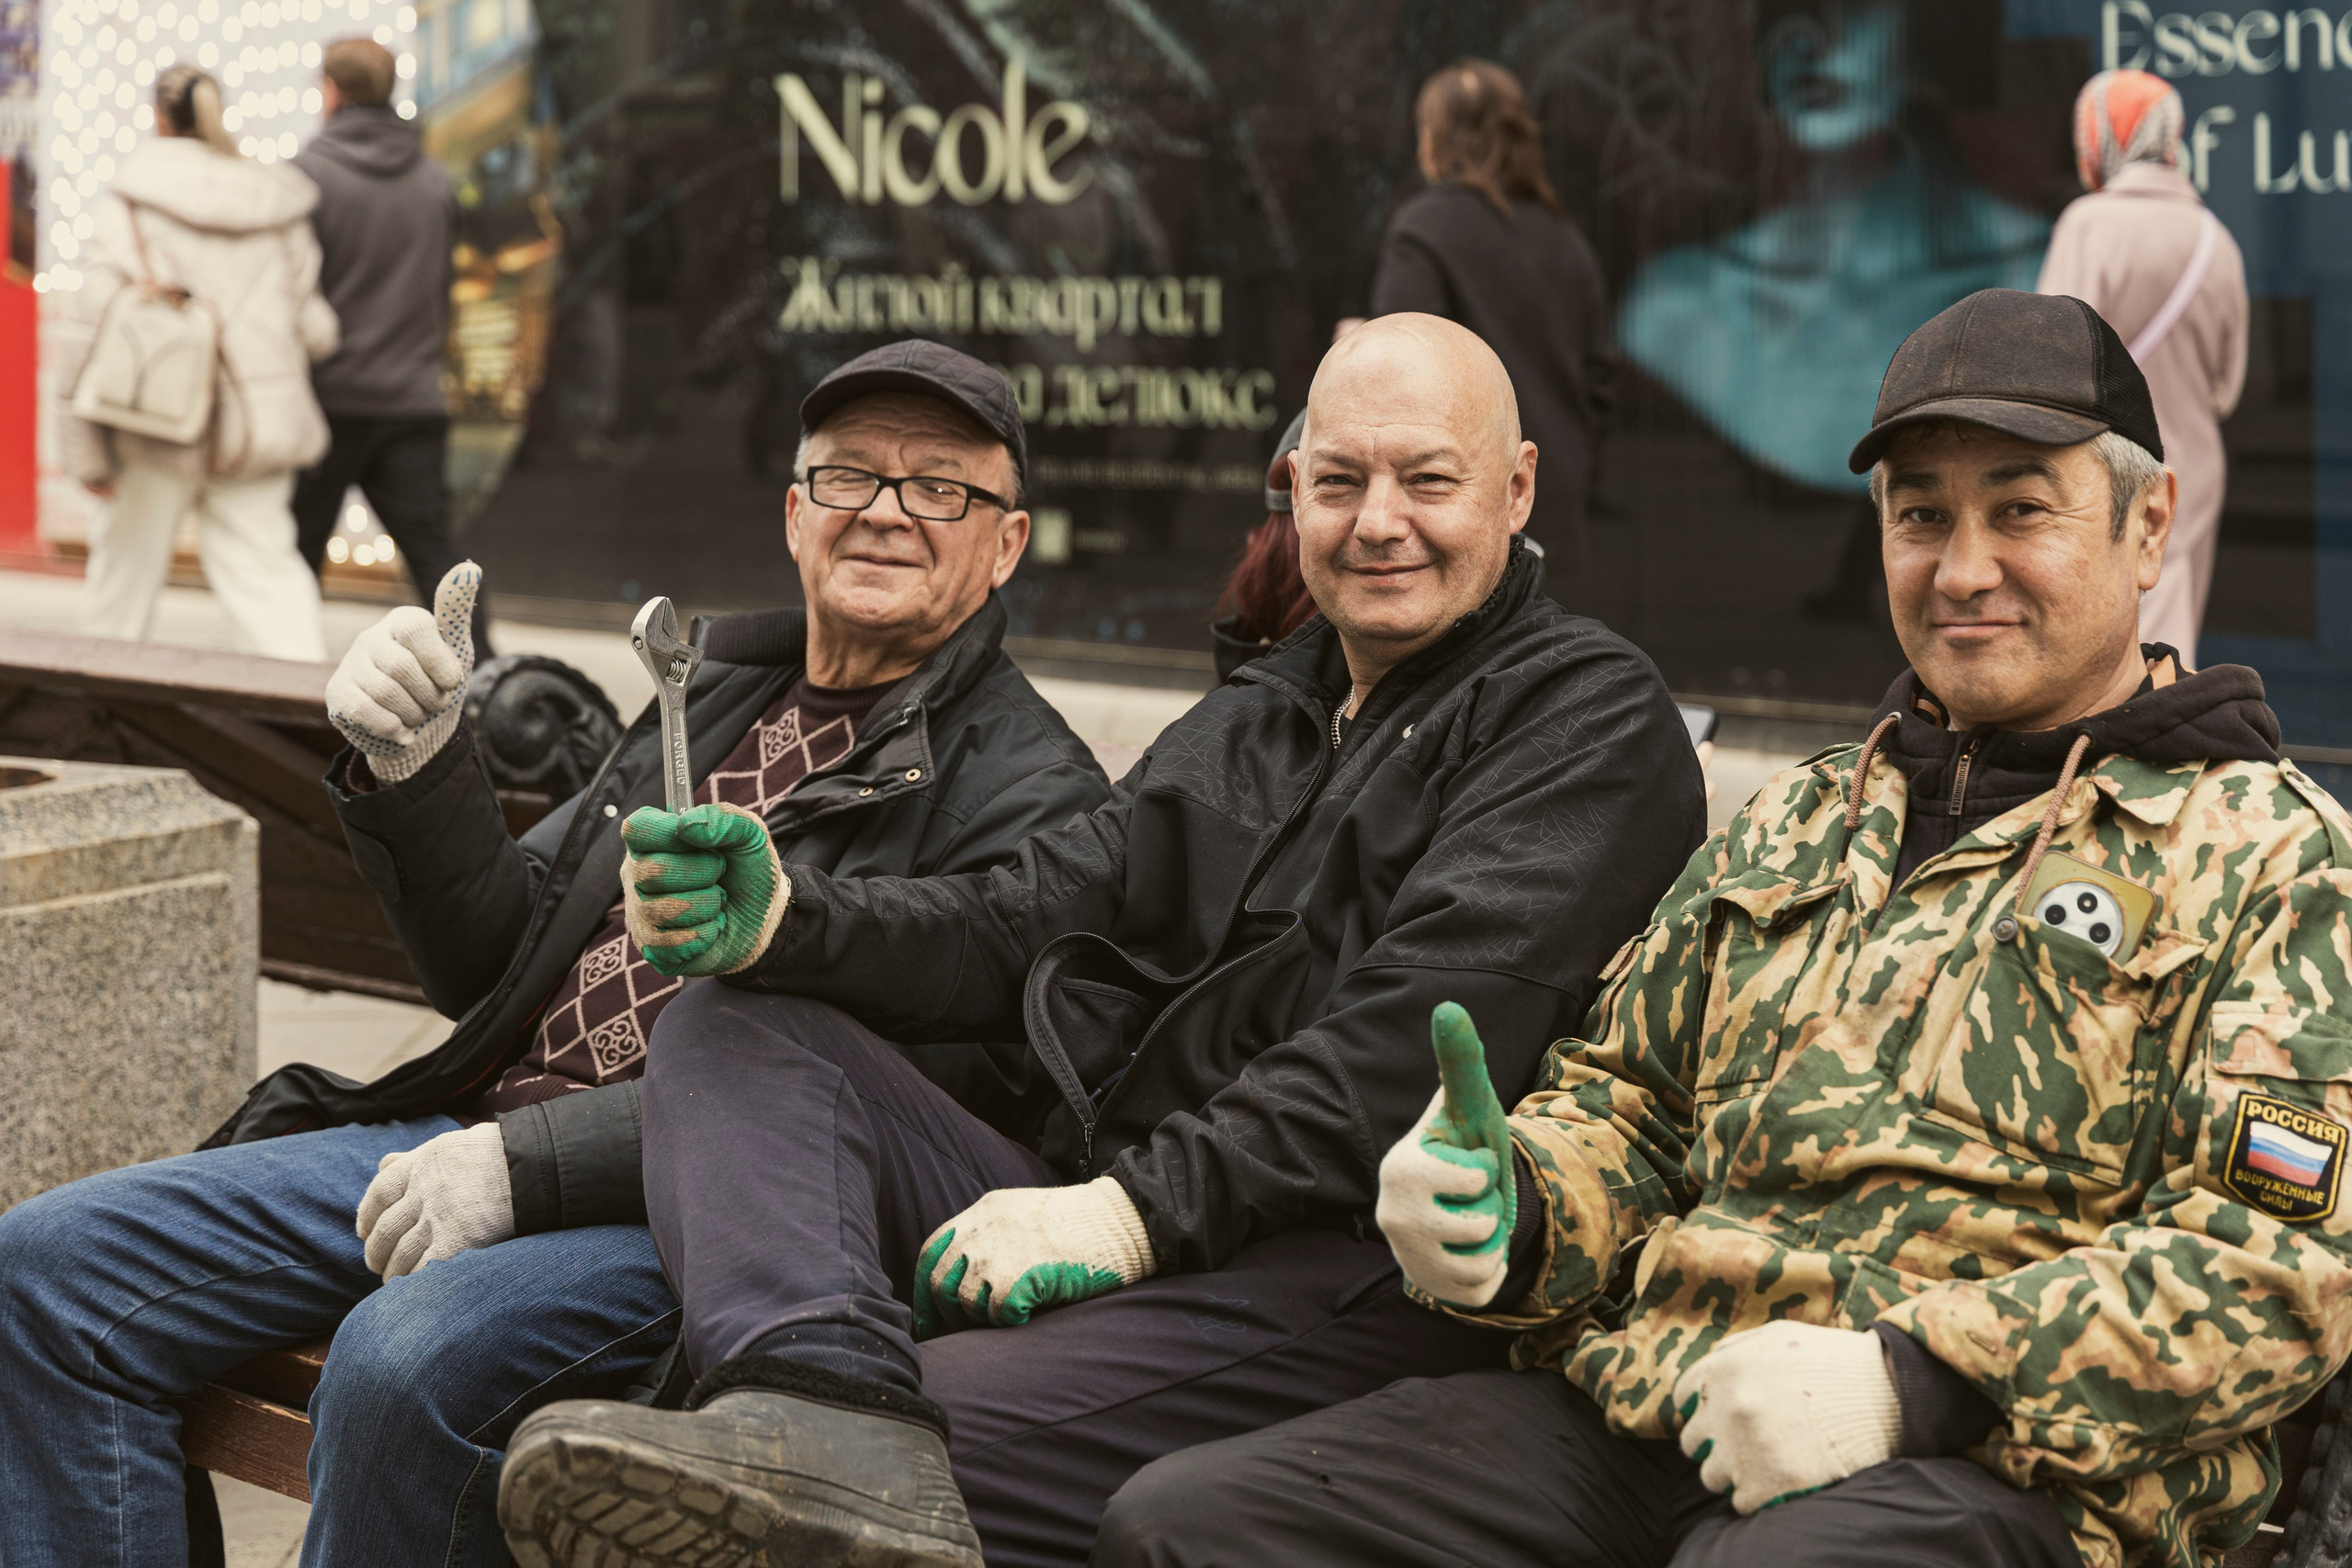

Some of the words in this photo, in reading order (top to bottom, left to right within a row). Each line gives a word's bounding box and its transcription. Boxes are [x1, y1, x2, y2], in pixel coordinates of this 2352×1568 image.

[775, 57, 1097, 206] Nicole
[2177, 105, 2236, 195] f
[979, 276, 1225, 354] квартал
[673, 732, 685, 785] FORGED
[2245, 1100, 2341, 1145] РОССИЯ
[2234, 1168, 2326, 1205] ВООРУЖЕННЫЕ
[2259, 1190, 2294, 1212] СИЛЫ
